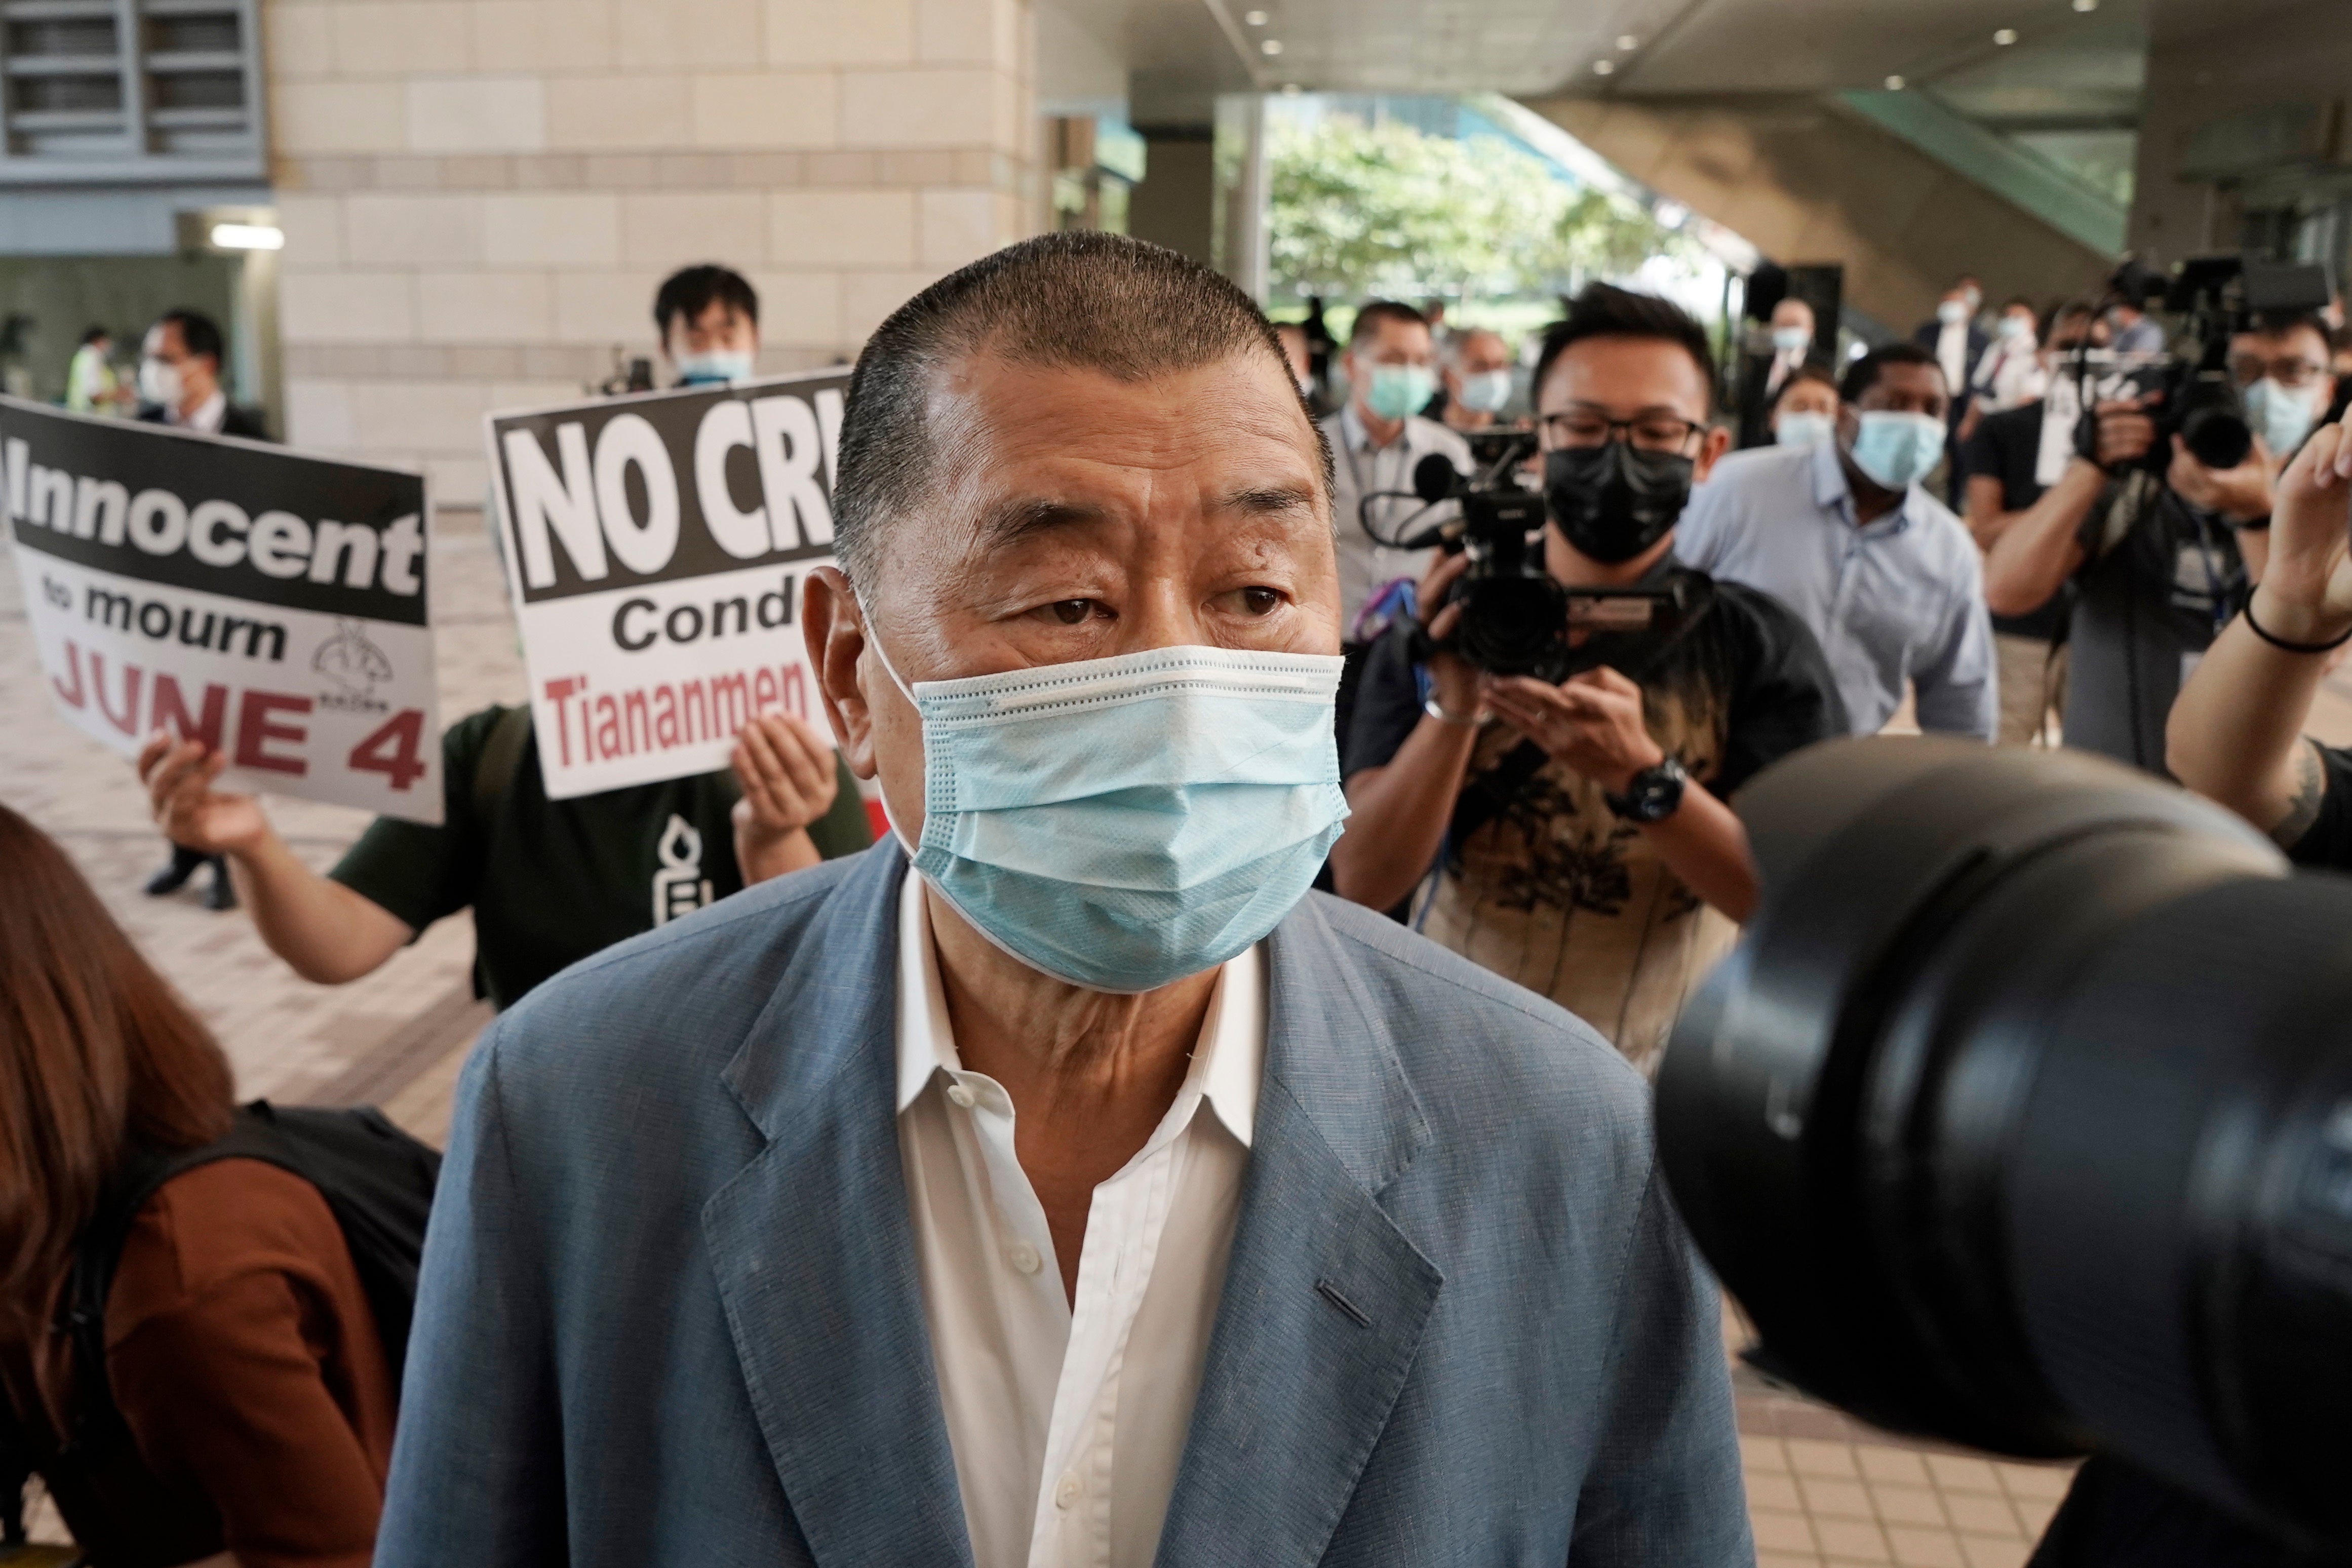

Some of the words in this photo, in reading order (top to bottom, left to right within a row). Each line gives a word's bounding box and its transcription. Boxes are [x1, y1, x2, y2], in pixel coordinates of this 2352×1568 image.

[6, 436, 425, 597] Innocent
[504, 413, 680, 590] NO
[42, 575, 73, 610] to
[86, 583, 287, 661] mourn
[52, 638, 313, 776] JUNE
[347, 708, 427, 791] 4
[544, 661, 808, 768] Tiananmen
